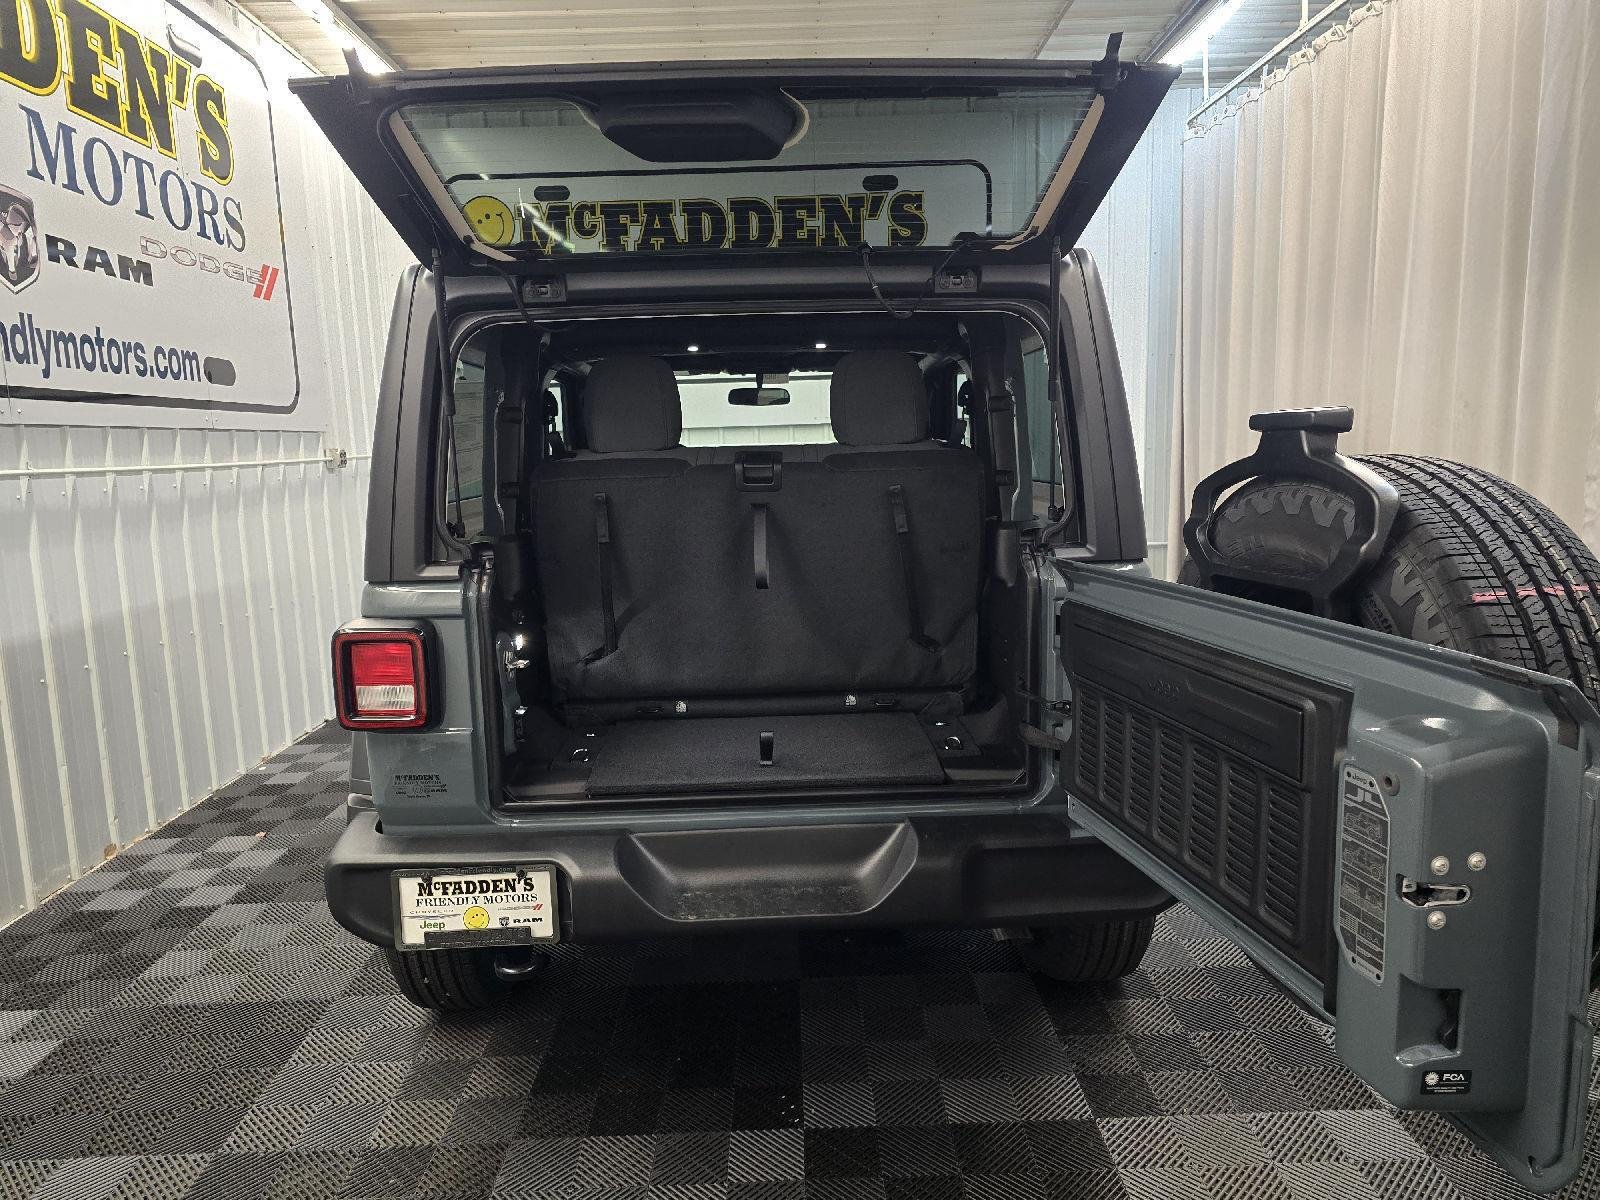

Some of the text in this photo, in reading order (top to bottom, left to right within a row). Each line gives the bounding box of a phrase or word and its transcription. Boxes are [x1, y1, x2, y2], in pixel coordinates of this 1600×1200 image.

[18, 103, 246, 253] MOTORS
[45, 234, 153, 287] RAM
[140, 235, 263, 286] DODGE
[415, 893, 538, 907] FRIENDLY MOTORS
[419, 920, 446, 931] Jeep
[1442, 1073, 1465, 1081] FCA
